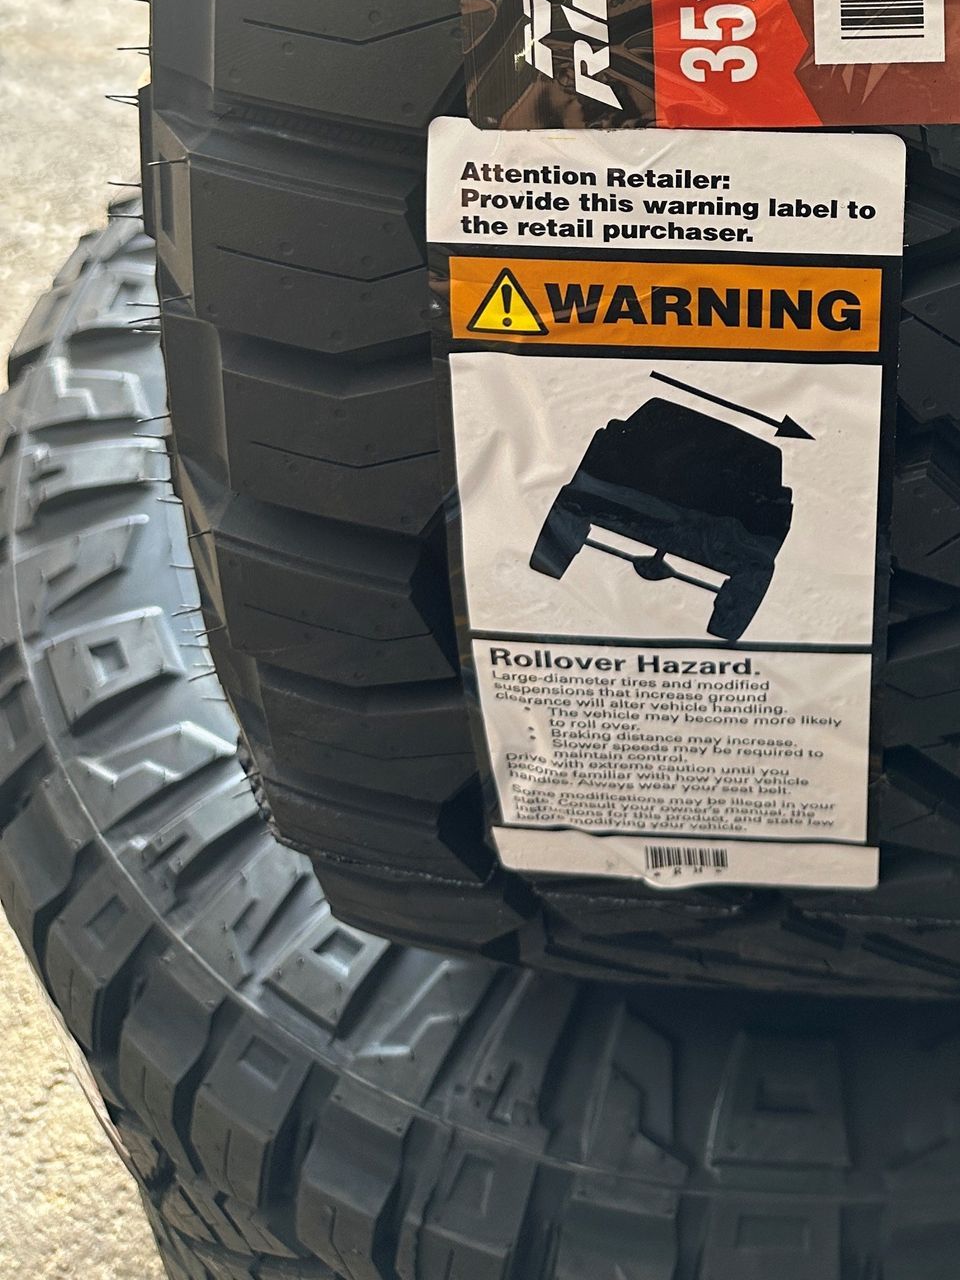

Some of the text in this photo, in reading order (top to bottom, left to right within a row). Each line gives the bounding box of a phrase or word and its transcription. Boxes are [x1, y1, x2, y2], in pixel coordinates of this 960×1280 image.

[461, 161, 731, 190] Attention Retailer:
[461, 189, 877, 220] Provide this warning label to
[461, 216, 754, 243] the retail purchaser.
[544, 282, 862, 331] WARNING
[490, 648, 760, 675] Rollover Hazard.
[492, 670, 769, 690] Large-diameter tires and modified
[494, 682, 767, 702] suspensions that increase ground
[496, 692, 788, 715] clearance will alter vehicle handling.
[548, 707, 841, 727] The vehicle may become more likely
[549, 718, 640, 730] to roll over.
[552, 729, 798, 747] Braking distance may increase.
[552, 739, 824, 758] Slower speeds may be required to
[554, 750, 688, 762] maintain control.
[506, 752, 789, 777] Drive with extreme caution until you
[508, 762, 809, 786] become familiar with how your vehicle
[578, 778, 634, 790] Always
[639, 782, 677, 790] wear
[682, 784, 716, 792] your
[560, 791, 664, 803] modifications
[670, 797, 702, 806] may
[708, 797, 726, 805] be
[781, 800, 796, 808] in
[800, 802, 836, 810] your
